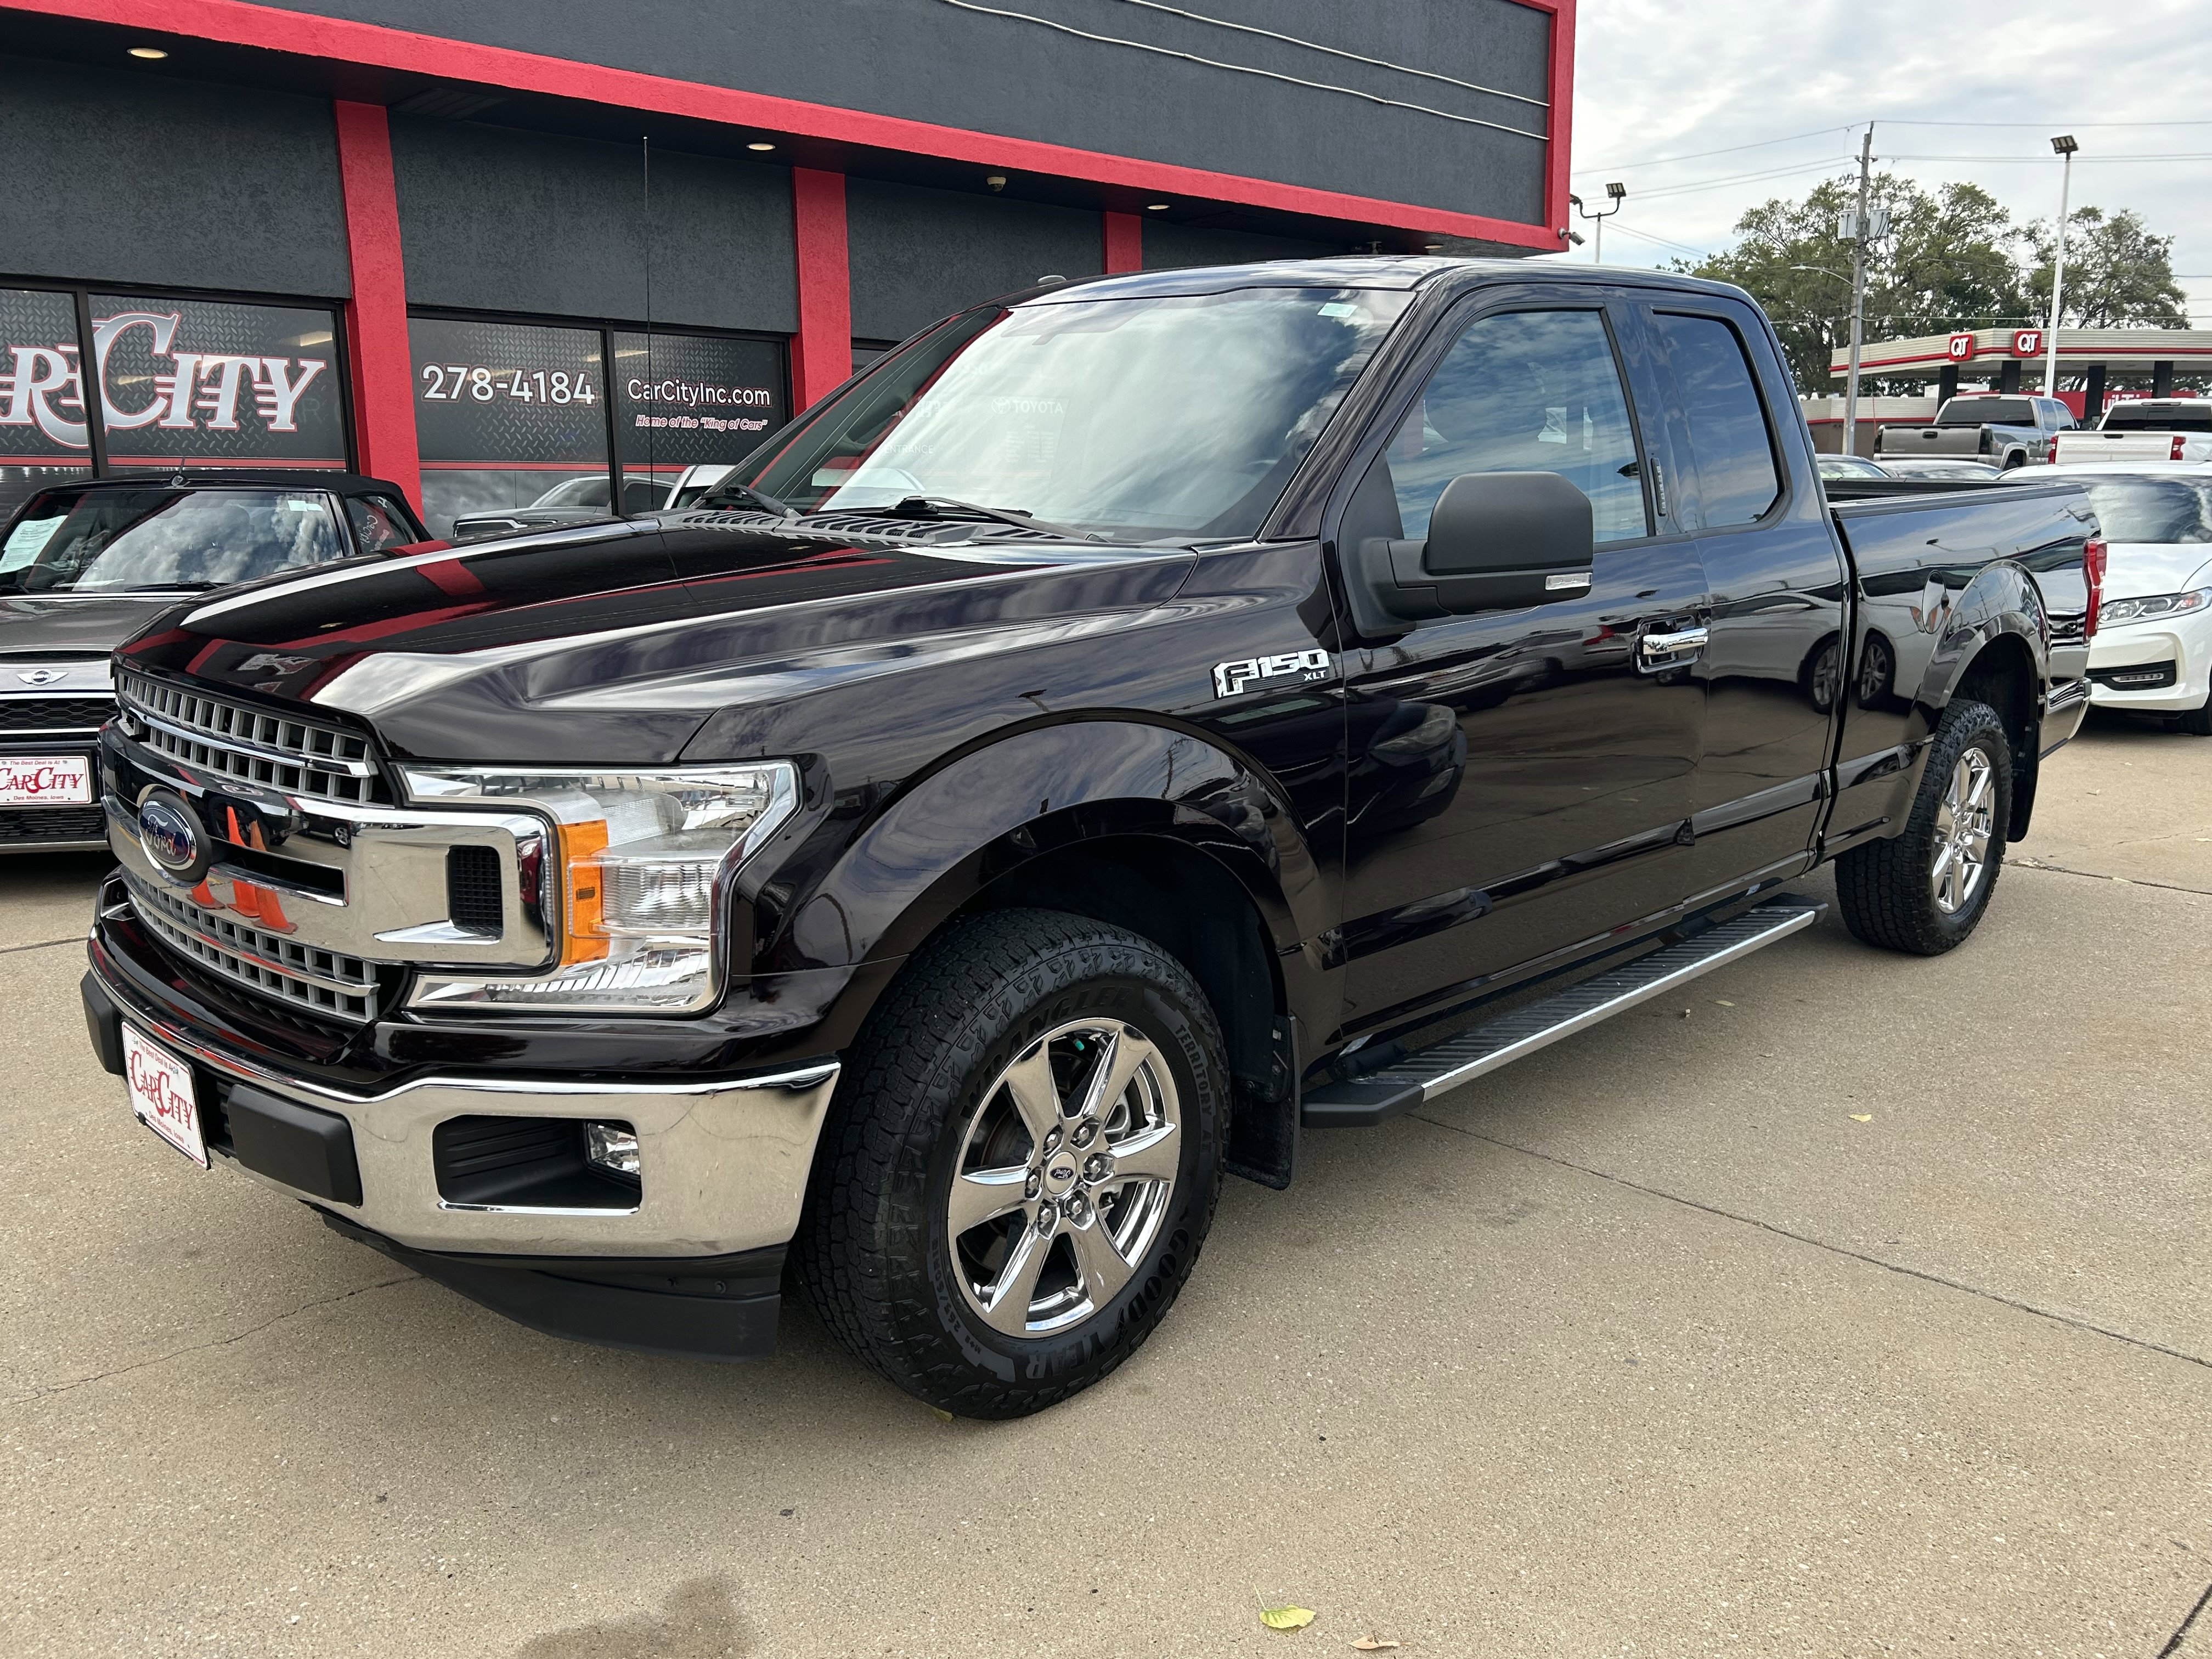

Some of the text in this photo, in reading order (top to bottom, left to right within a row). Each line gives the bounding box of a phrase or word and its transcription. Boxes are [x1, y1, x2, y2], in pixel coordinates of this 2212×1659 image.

[1951, 337, 1968, 356] QT
[2018, 334, 2038, 352] QT
[421, 364, 596, 406] 278-4184
[628, 379, 771, 407] CarCityInc.com
[1011, 400, 1064, 414] TOYOTA
[635, 415, 667, 427] Home
[669, 416, 682, 428] of
[681, 416, 698, 428] the
[727, 417, 741, 430] of
[884, 444, 933, 454] ENTRANCE
[1303, 670, 1327, 681] XLT
[145, 814, 176, 856] Ford
[1175, 1024, 1212, 1116] TERRITORY
